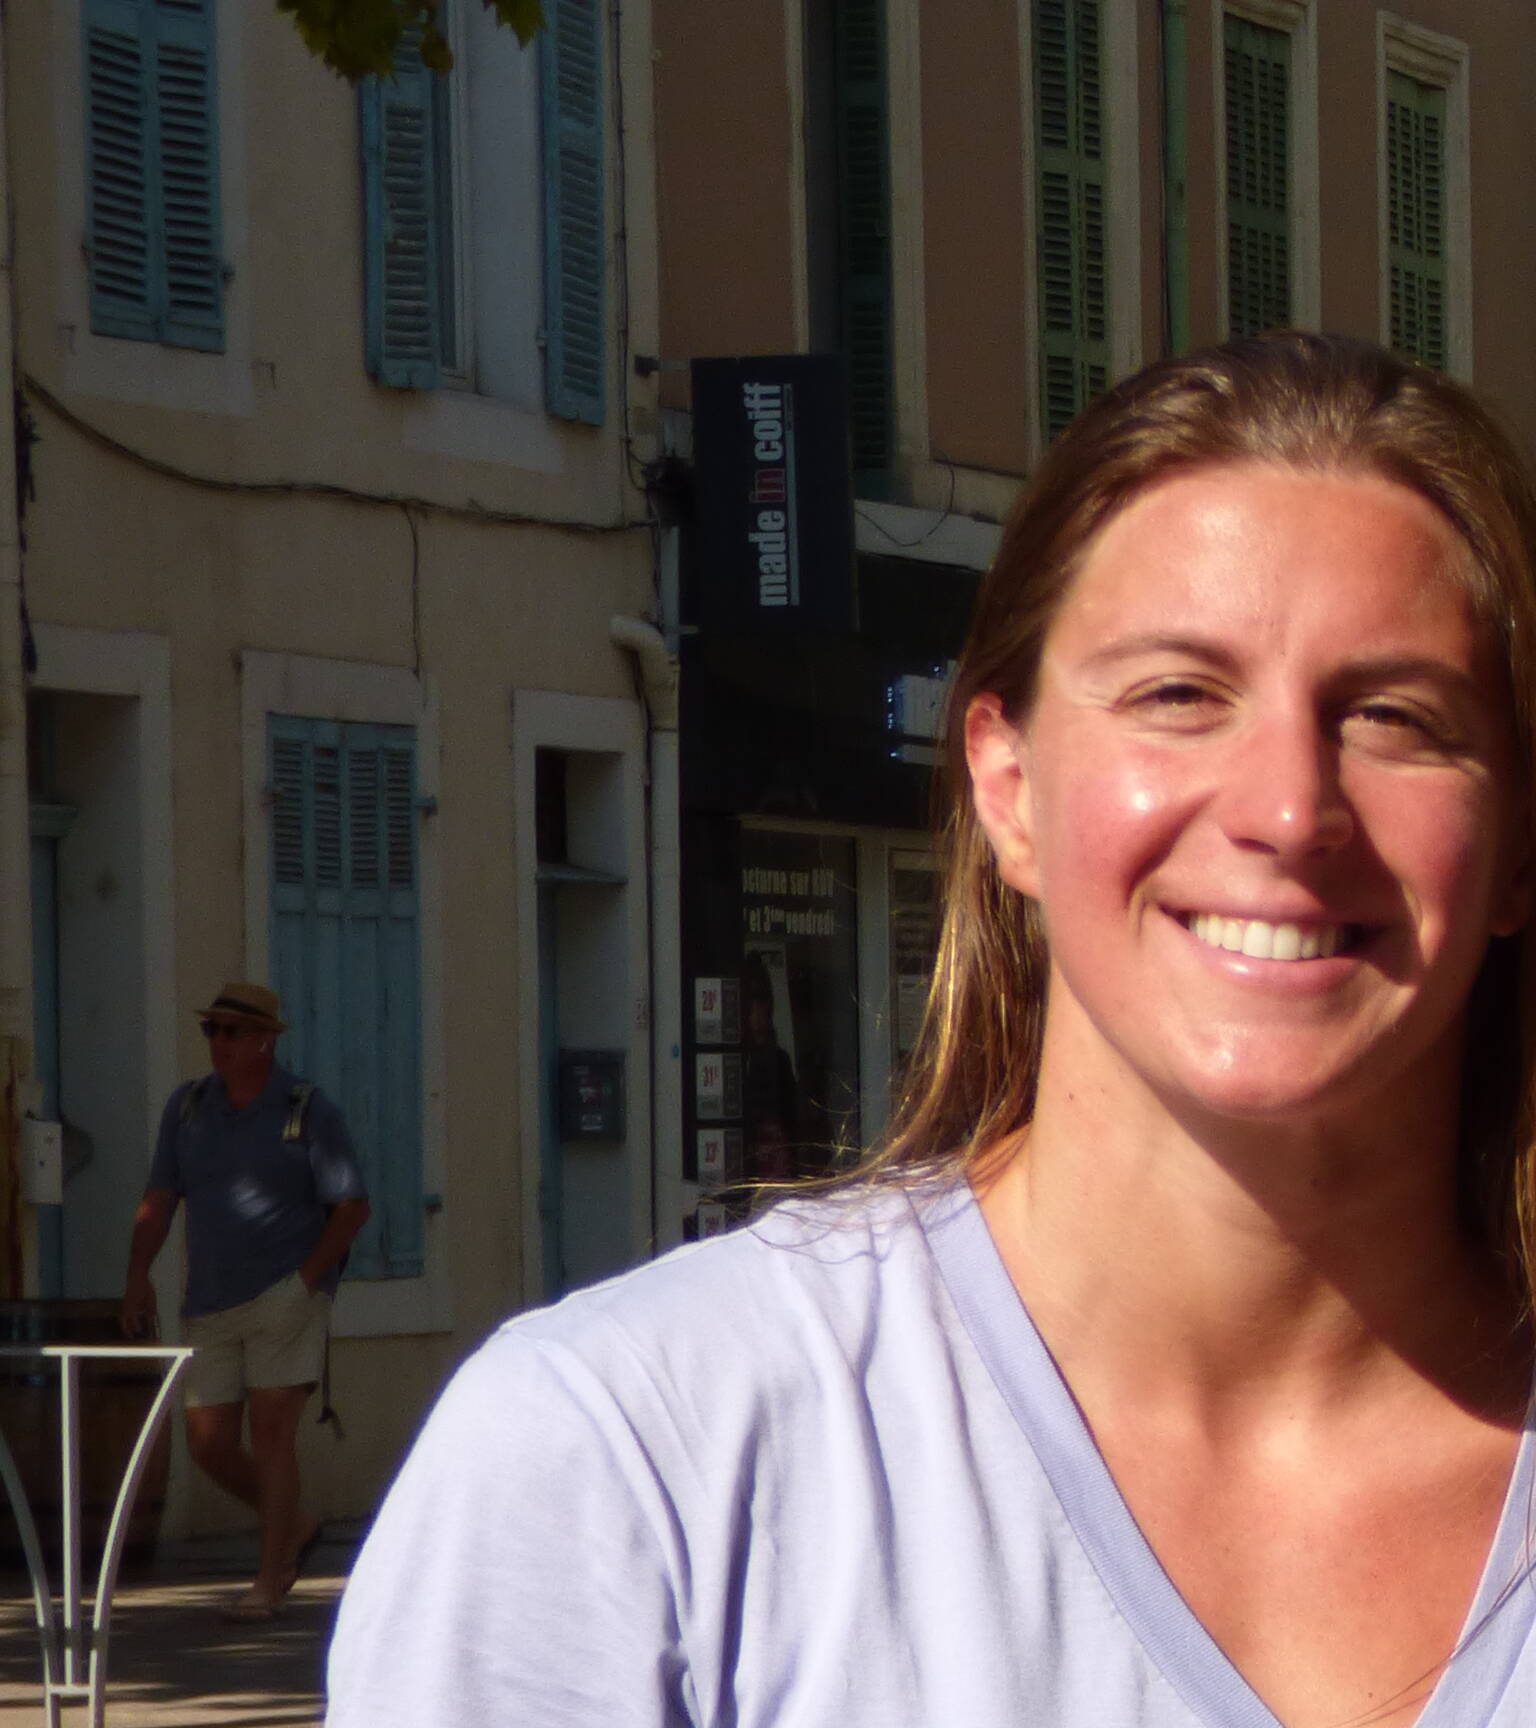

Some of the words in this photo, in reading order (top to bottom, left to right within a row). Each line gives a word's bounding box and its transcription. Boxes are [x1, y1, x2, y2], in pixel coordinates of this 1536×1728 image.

[743, 382, 784, 461] coiff
[749, 468, 785, 503] in
[748, 509, 788, 607] made
